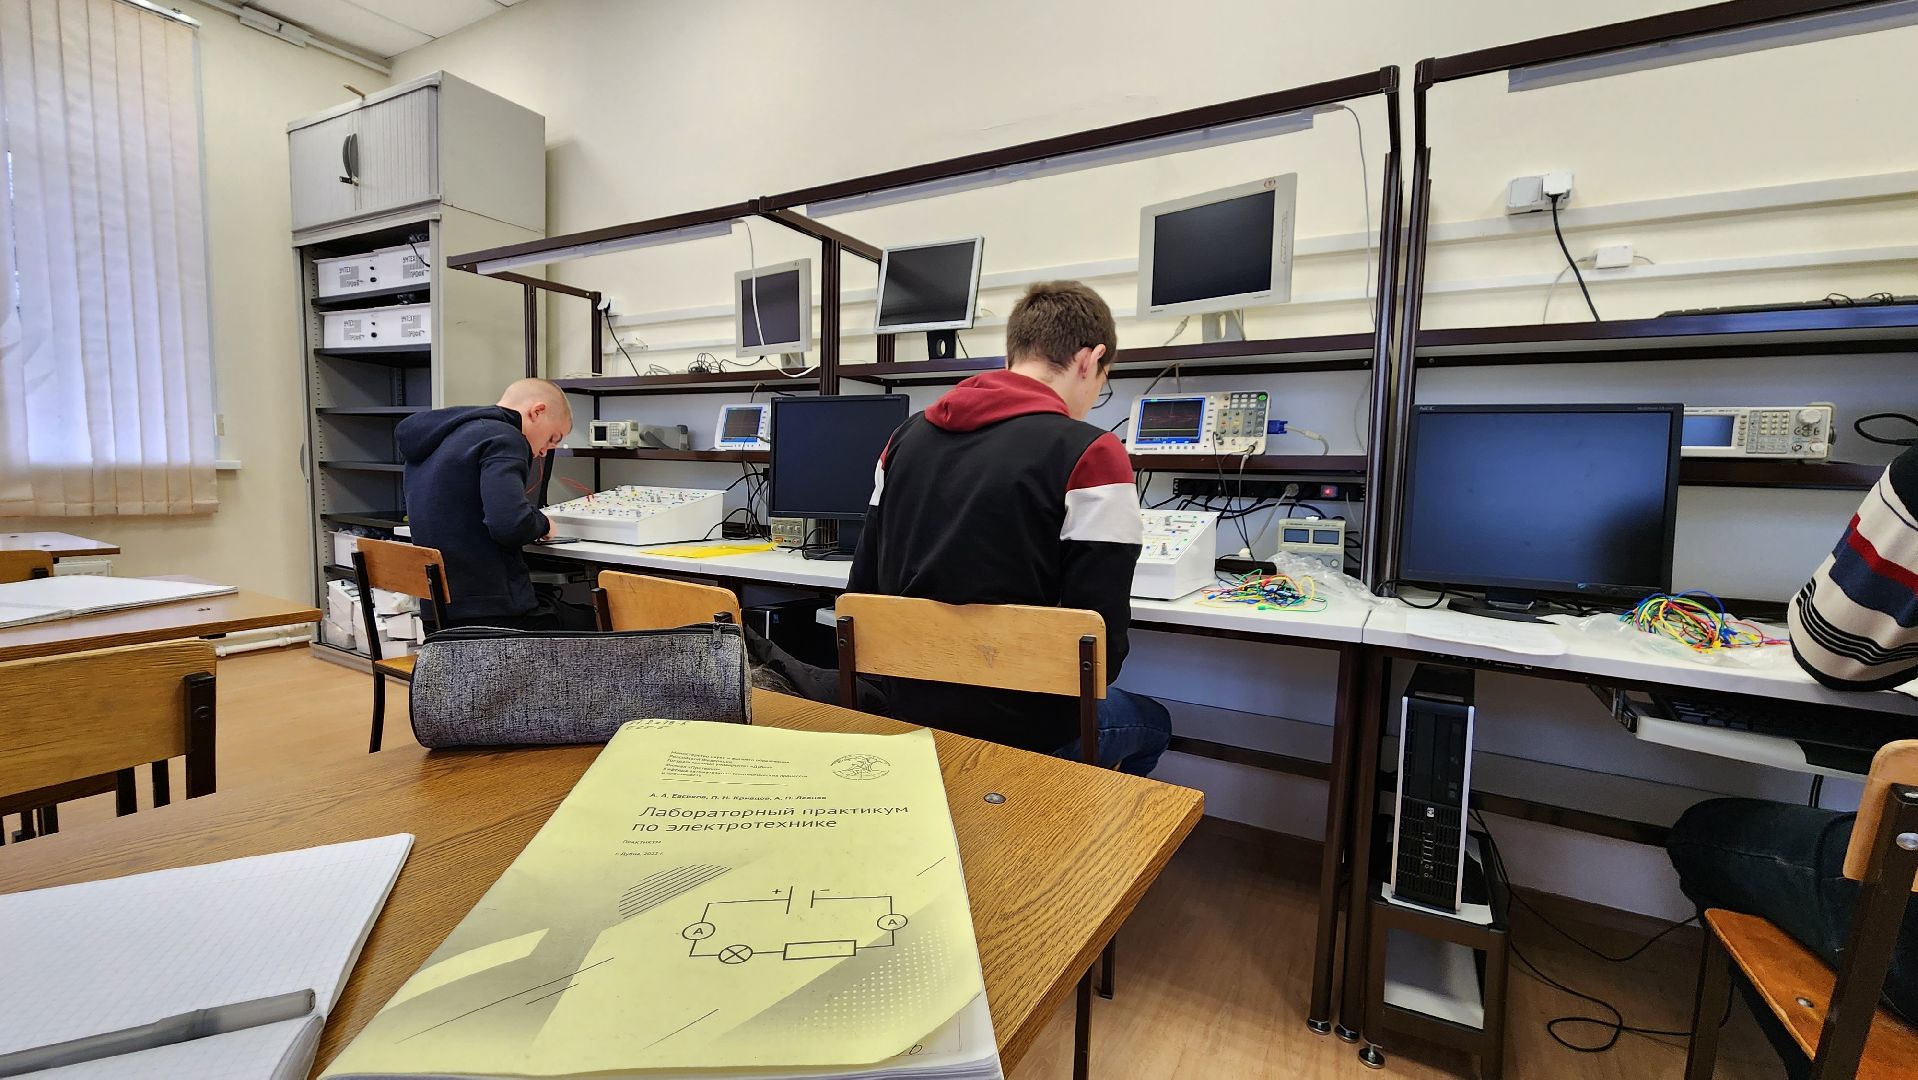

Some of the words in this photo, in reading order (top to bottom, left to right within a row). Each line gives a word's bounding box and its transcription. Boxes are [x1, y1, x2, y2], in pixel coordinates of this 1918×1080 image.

[639, 806, 795, 819] Лабораторный
[802, 806, 909, 817] практикум
[631, 822, 659, 832] по
[665, 819, 837, 832] электротехнике
